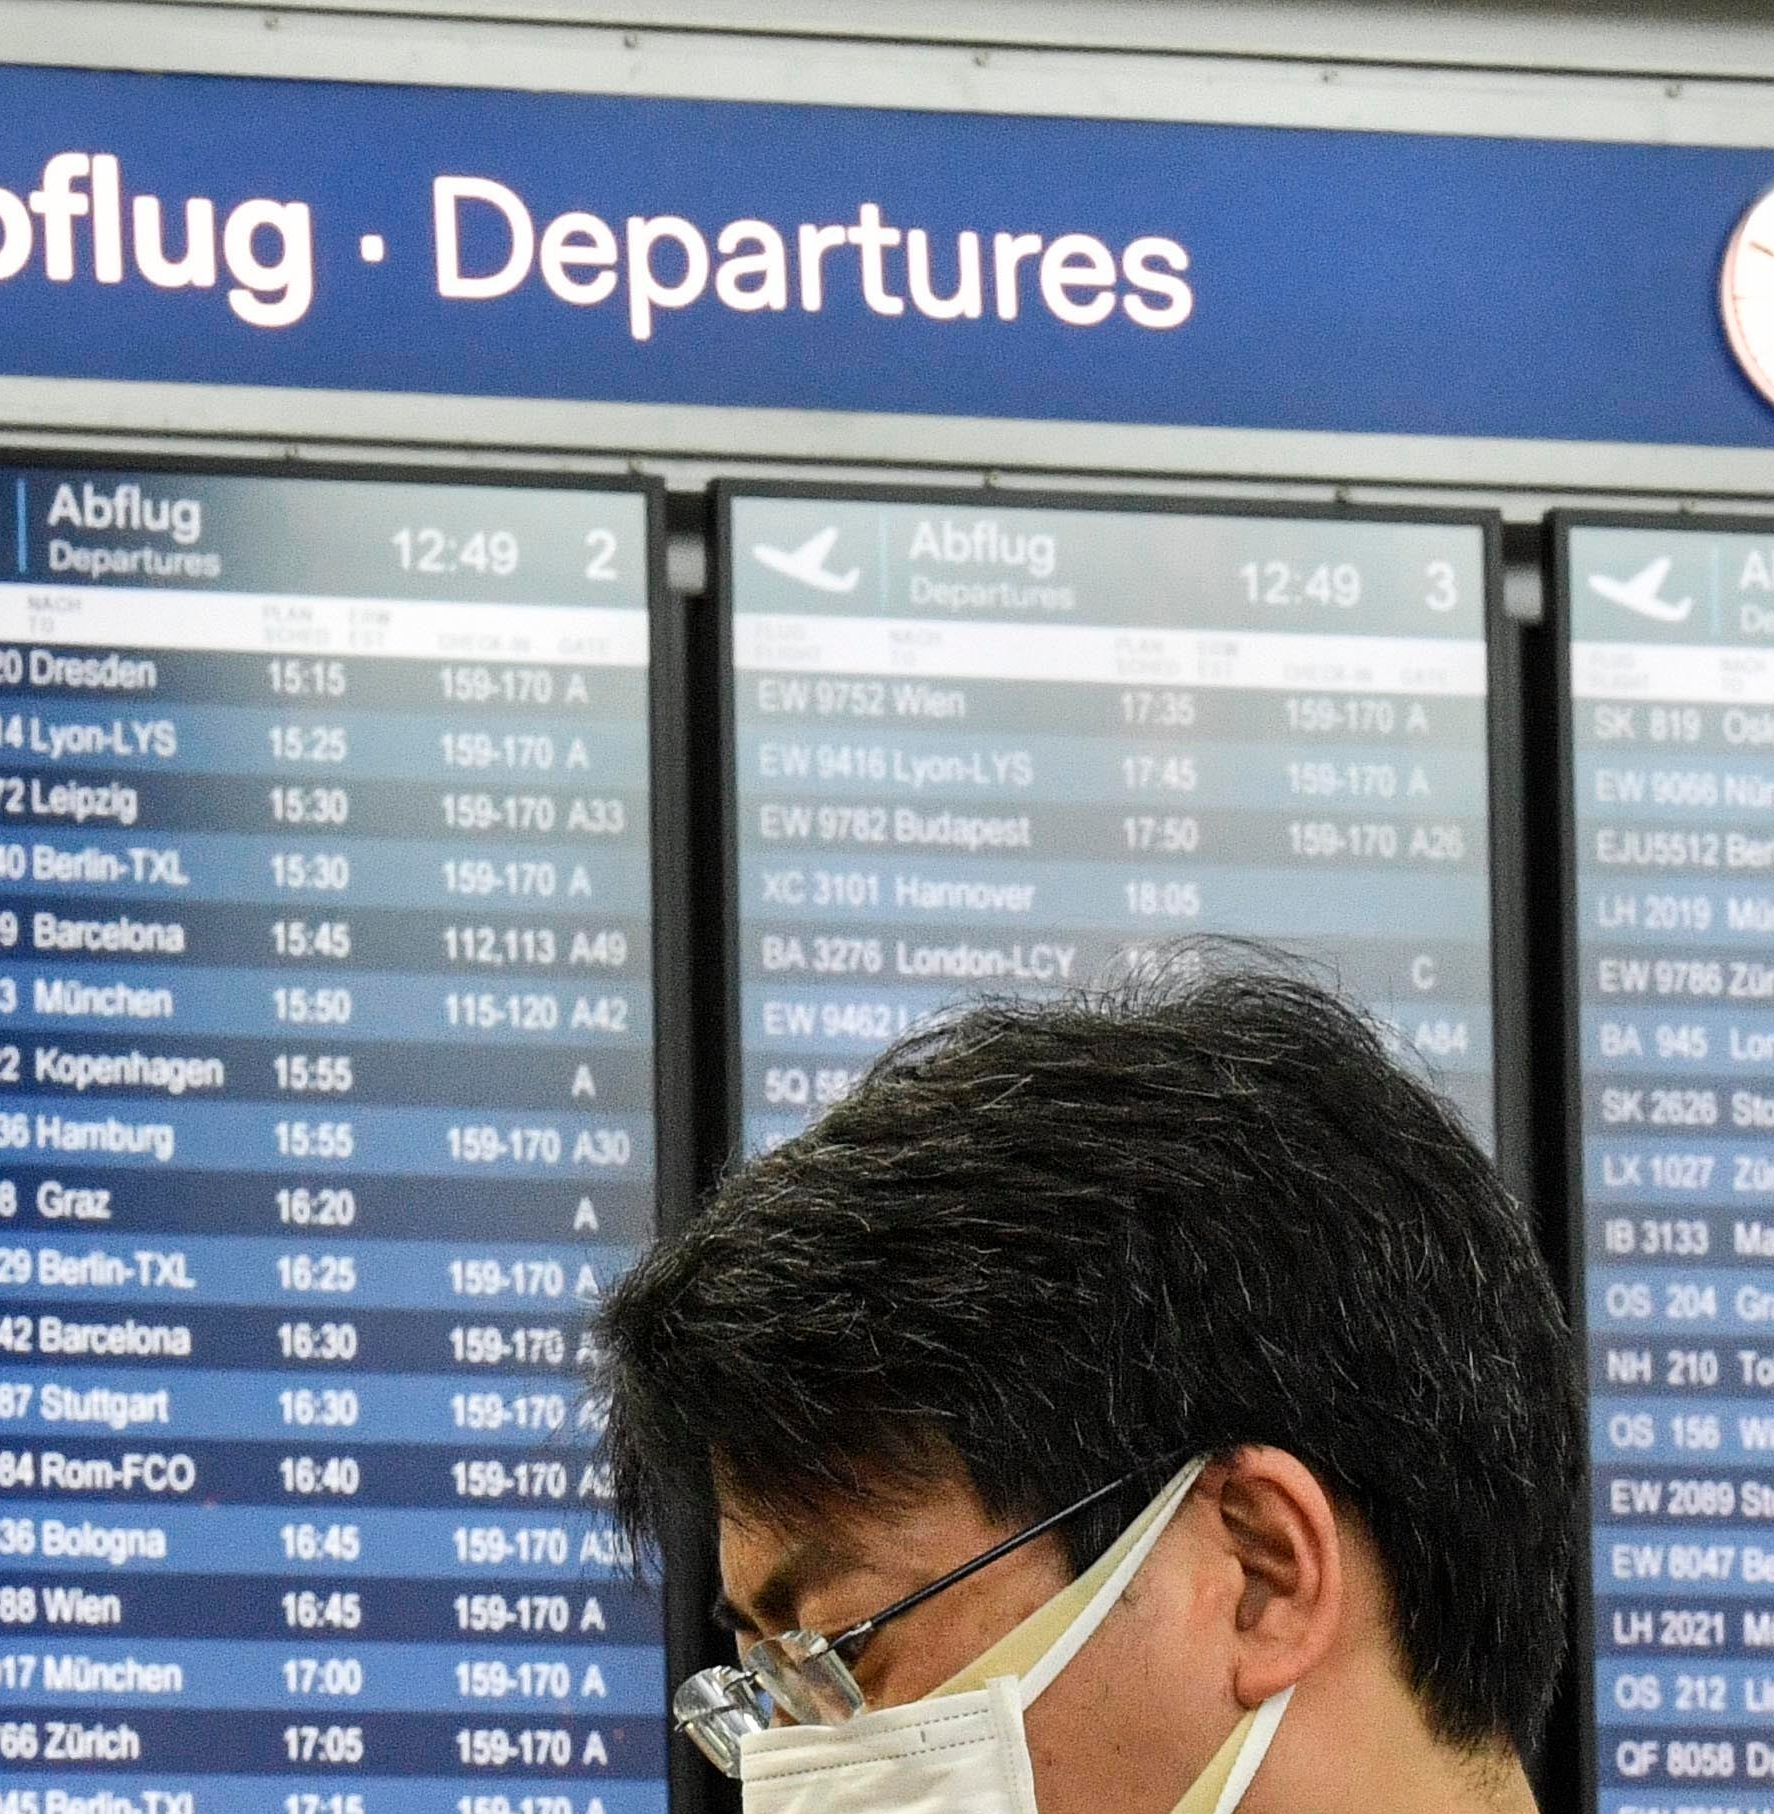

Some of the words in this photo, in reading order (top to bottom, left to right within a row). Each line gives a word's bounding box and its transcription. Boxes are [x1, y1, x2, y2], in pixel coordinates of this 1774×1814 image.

[433, 175, 1193, 341] Departures
[47, 483, 206, 546] Abflug
[392, 527, 520, 576] 12:49
[585, 528, 617, 580] 2
[47, 538, 222, 579] Departures
[908, 518, 1056, 577] Abflug
[1240, 560, 1362, 608] 12:49
[1425, 560, 1458, 612] 3
[909, 573, 1075, 612] Departures
[29, 649, 158, 690] Dresden
[269, 660, 347, 697] 15:15
[439, 666, 553, 704] 159-170
[565, 673, 588, 703] A
[758, 682, 810, 713] EW
[891, 686, 966, 719] Wien
[1122, 693, 1195, 726] 17:35
[1286, 698, 1393, 731] 159-170
[1407, 702, 1428, 733] A
[33, 912, 186, 954] Barcelona
[272, 921, 351, 958] 15:45
[443, 926, 557, 965] 112,113
[36, 1180, 112, 1219] Graz
[276, 1187, 356, 1226] 16:20
[573, 1197, 599, 1230] A
[1607, 1350, 1652, 1383] NH
[1667, 1349, 1719, 1386] 210
[1613, 1611, 1654, 1645] LH
[1659, 1610, 1725, 1646] 2021
[43, 1655, 183, 1693] München
[283, 1658, 363, 1695] 17:00
[455, 1660, 571, 1698] 159-170
[581, 1664, 607, 1698] A
[1614, 1674, 1662, 1710] OS
[1674, 1674, 1727, 1711] 212
